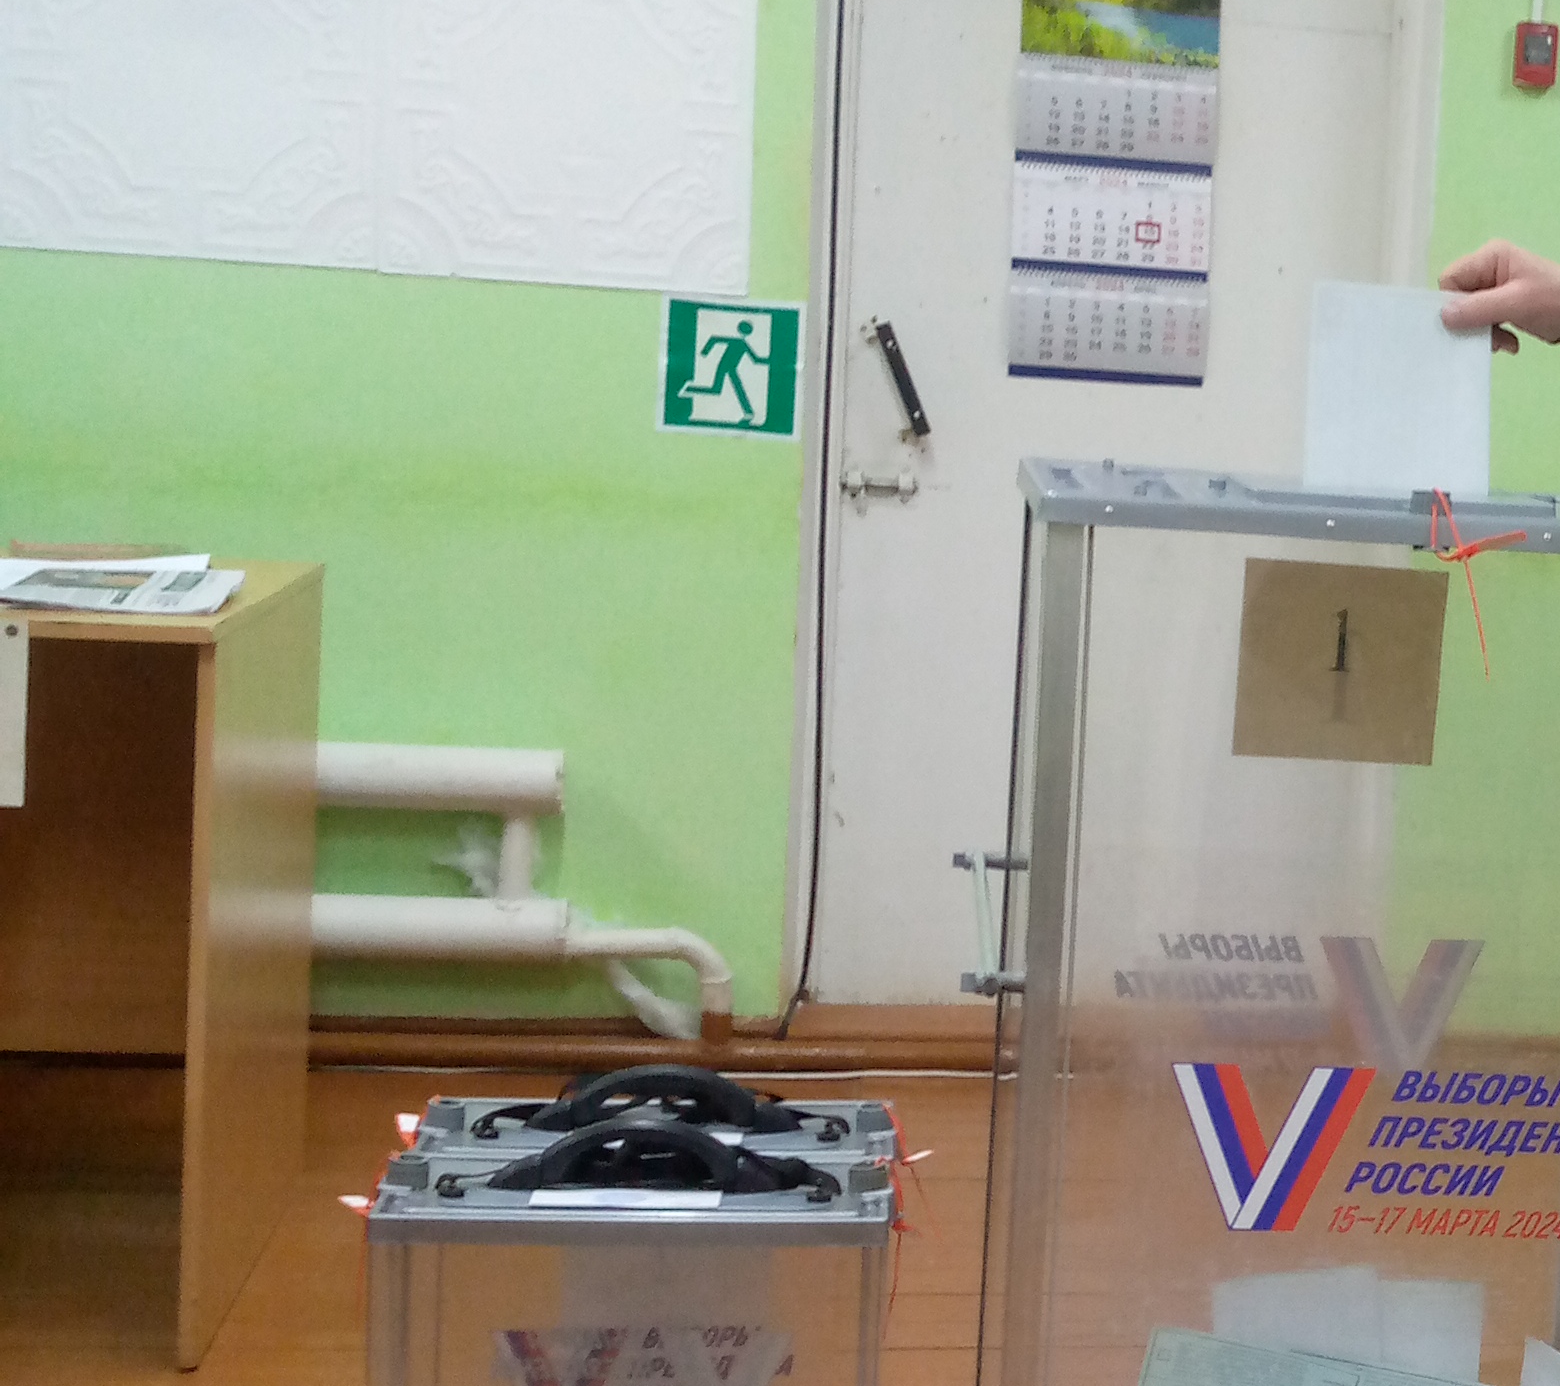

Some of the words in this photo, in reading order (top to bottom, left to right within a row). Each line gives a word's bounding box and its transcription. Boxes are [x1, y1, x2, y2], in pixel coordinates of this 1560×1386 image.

[1329, 609, 1350, 673] 1
[1345, 1162, 1505, 1197] РОССИИ
[1405, 1207, 1500, 1238] МАРТА
